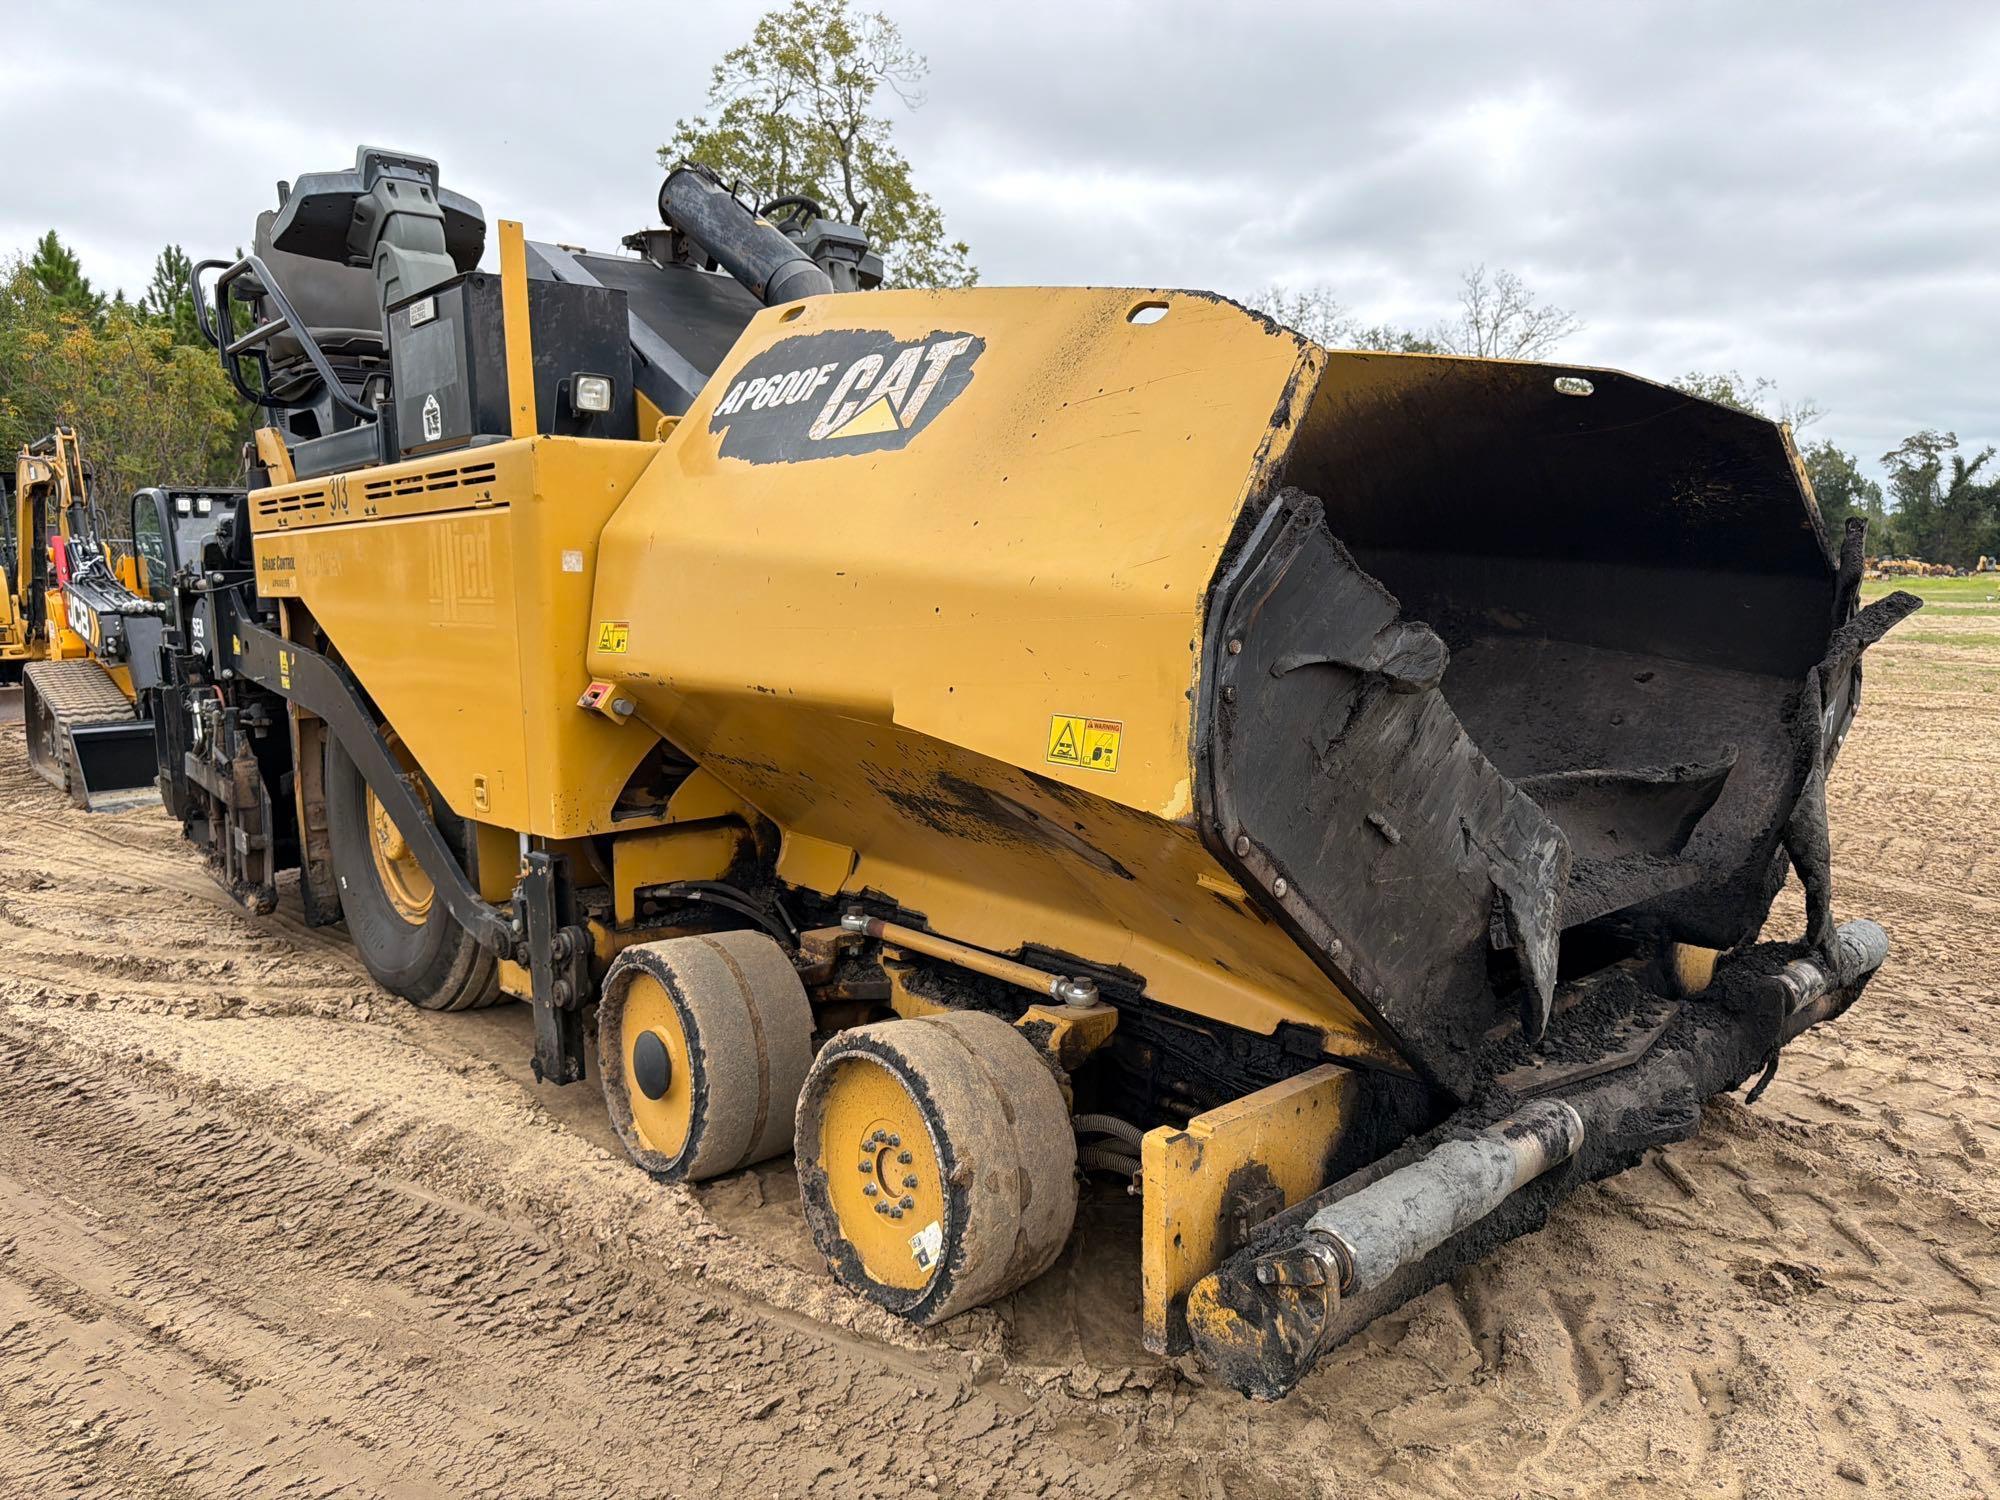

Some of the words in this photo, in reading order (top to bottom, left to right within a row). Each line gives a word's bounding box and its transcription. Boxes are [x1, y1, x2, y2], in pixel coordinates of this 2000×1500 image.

[714, 362, 839, 416] AP600F
[809, 336, 974, 440] CAT
[329, 475, 348, 510] 313
[67, 591, 90, 640] JCB
